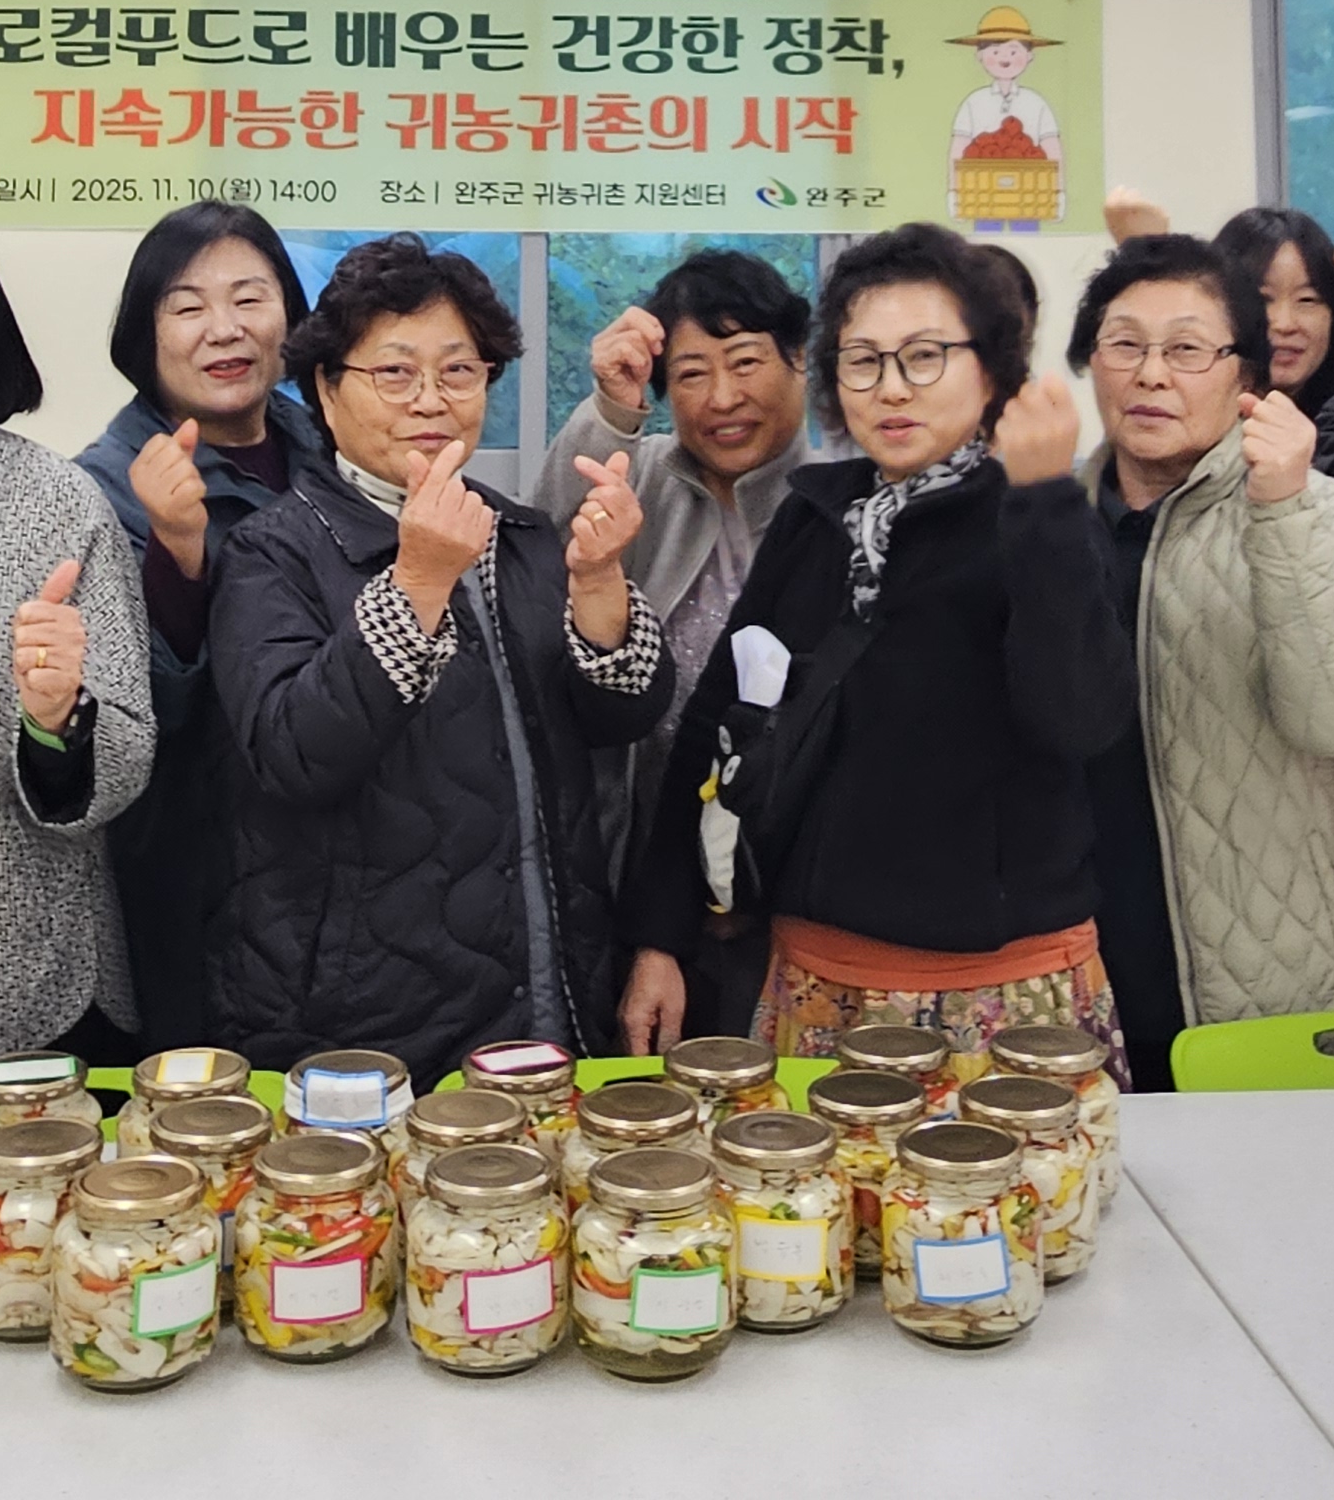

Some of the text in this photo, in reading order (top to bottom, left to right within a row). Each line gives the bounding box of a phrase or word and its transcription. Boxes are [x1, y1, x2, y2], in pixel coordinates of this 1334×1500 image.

[334, 11, 529, 71] 배우는
[552, 15, 743, 74] 건강한
[763, 18, 905, 79] 정착,
[30, 88, 860, 155] 지속가능한 귀농귀촌의 시작
[71, 178, 143, 202] 2025.
[152, 178, 179, 202] 11.
[270, 179, 338, 202] 14:00
[380, 180, 427, 204] 장소
[454, 181, 525, 205] 완주군
[533, 182, 626, 206] 귀농귀촌
[634, 183, 727, 207] 지원센터
[805, 186, 887, 208] 완주군
